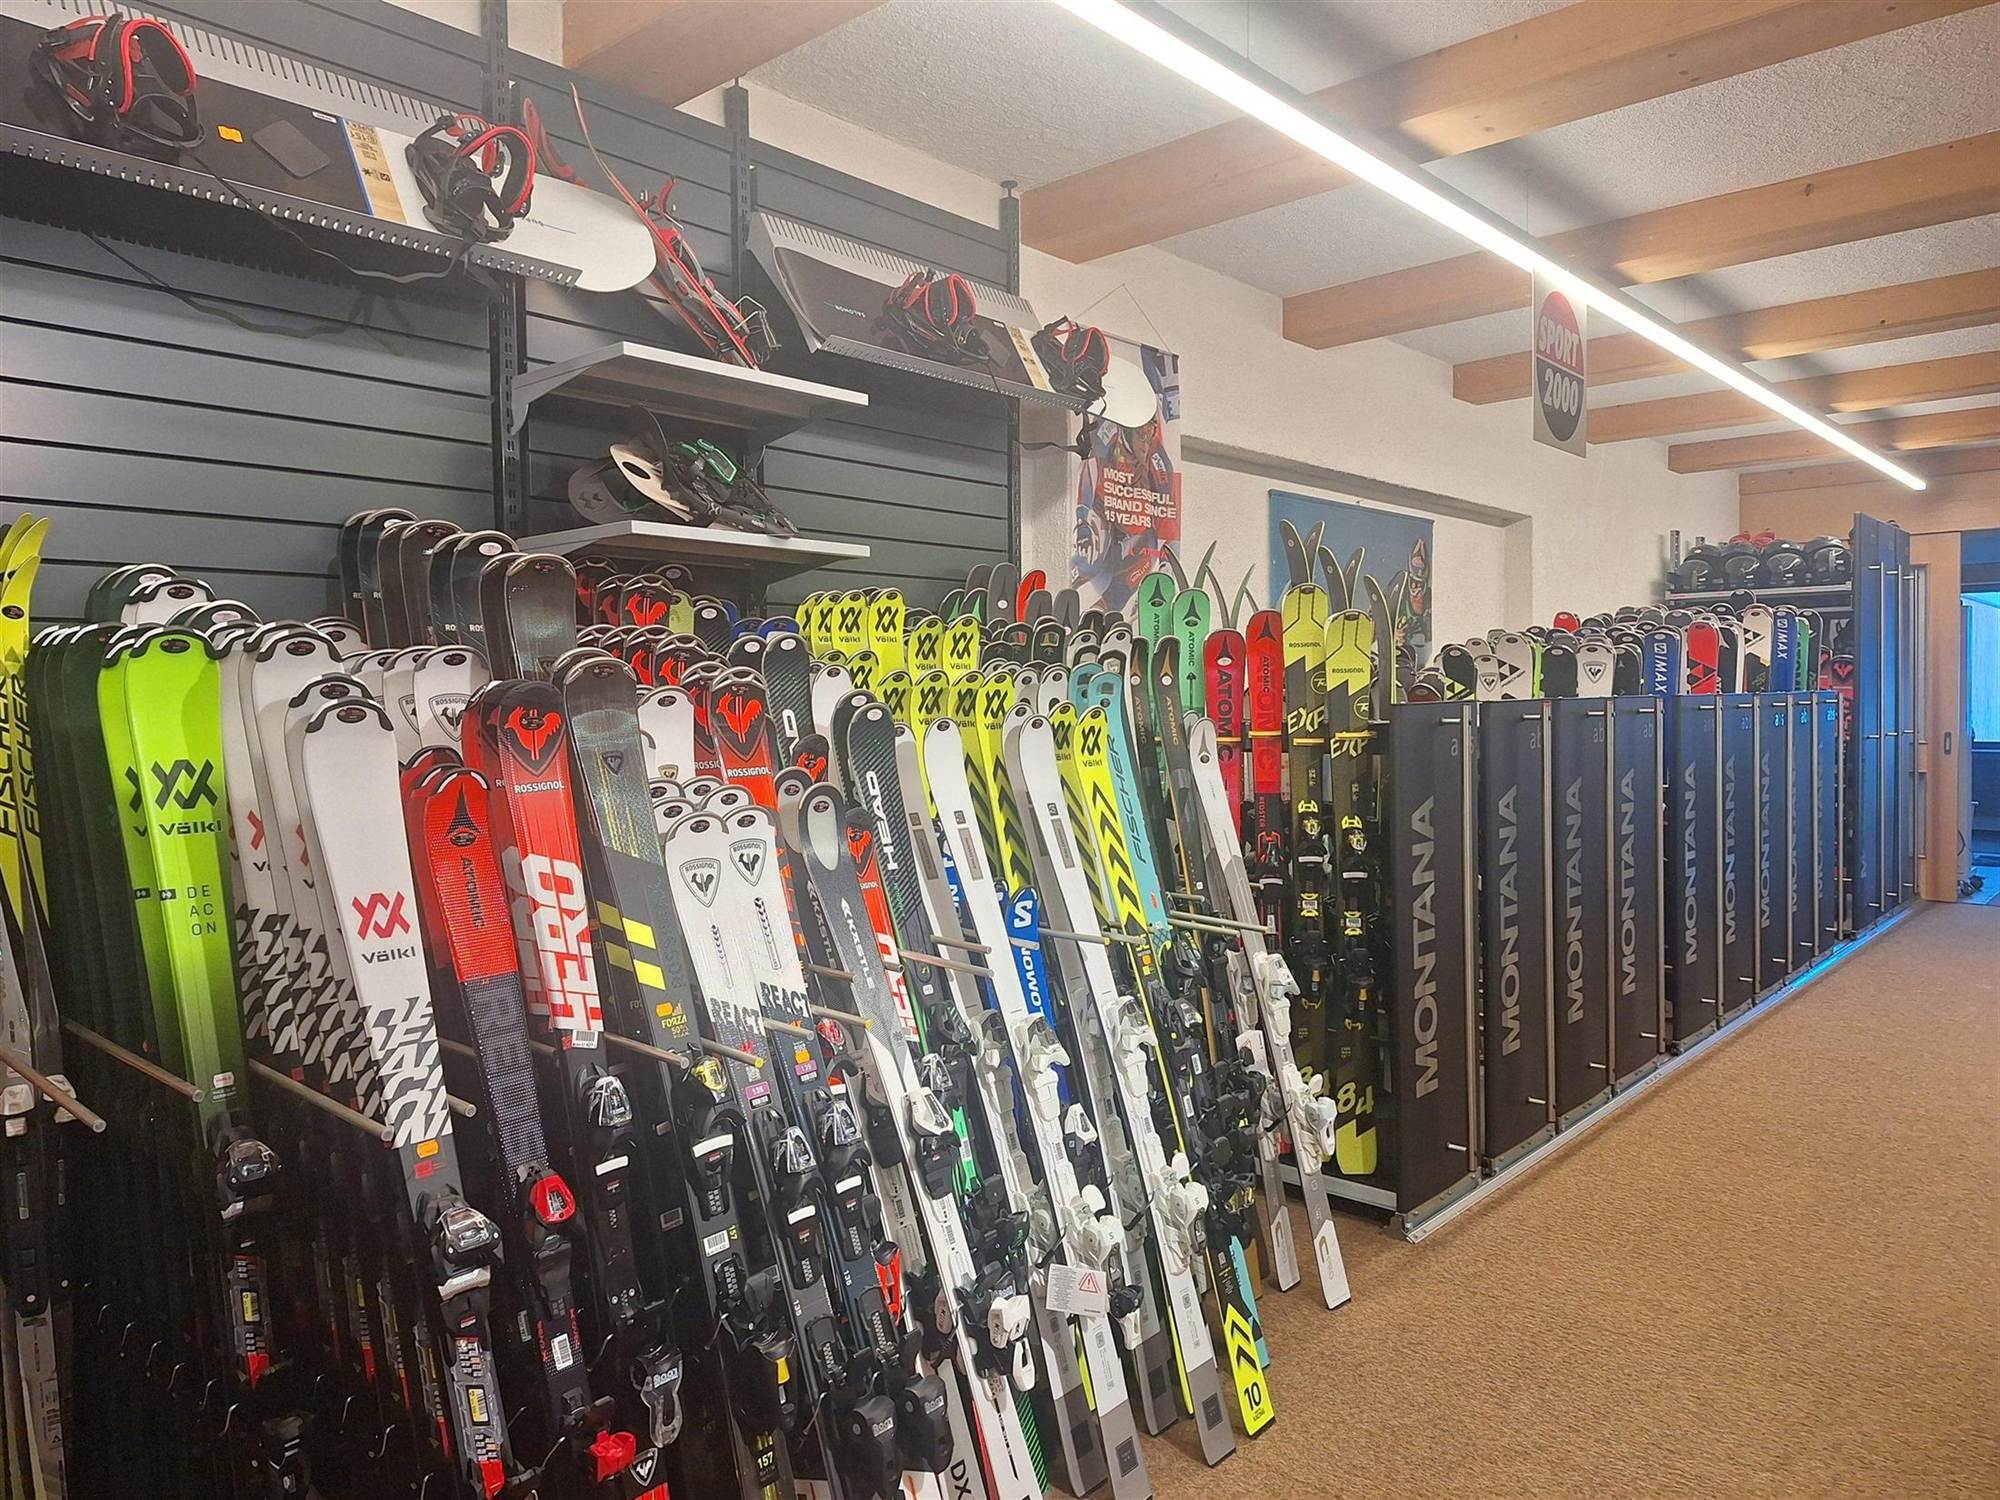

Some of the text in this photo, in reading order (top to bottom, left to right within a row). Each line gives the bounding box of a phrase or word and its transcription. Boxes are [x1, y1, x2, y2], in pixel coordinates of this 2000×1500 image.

[1538, 315, 1579, 366] SPORT
[1543, 367, 1579, 416] 2000
[1103, 467, 1135, 484] MOST
[1103, 481, 1175, 506] SUCCESSFUL
[1104, 495, 1177, 519] BRAND SINCE
[1104, 510, 1152, 528] 15 YEARS
[875, 635, 898, 643] Völkl
[1262, 656, 1270, 694] ATOMIC
[1134, 696, 1148, 745] ATOMIC
[1166, 696, 1179, 747] ATOMIC
[727, 766, 772, 778] ROSSIGNOL
[1082, 759, 1103, 767] Völkl
[514, 780, 565, 794] ROSSIGNOL
[1107, 734, 1147, 864] FISCHER
[159, 820, 222, 835] Völkl
[865, 770, 899, 871] HEAD
[1724, 754, 1737, 945] MONTANA
[1760, 751, 1771, 929] MONTANA
[684, 862, 716, 872] ROSSIGNOL
[1620, 767, 1636, 996] MONTANA
[1684, 760, 1697, 965] MONTANA
[460, 855, 486, 929] ATOMIC
[1566, 776, 1585, 1026] MONTANA
[1499, 784, 1522, 1057] MONTANA
[361, 946, 417, 965] Völkl
[521, 853, 605, 1032] HERO
[1411, 795, 1440, 1099] MONTANA
[710, 998, 766, 1036] REACT
[760, 981, 812, 1018] REACT
[661, 1014, 688, 1029] FORZA
[728, 1225, 738, 1240] 157
[1243, 1381, 1262, 1411] 10
[757, 1451, 774, 1469] 157
